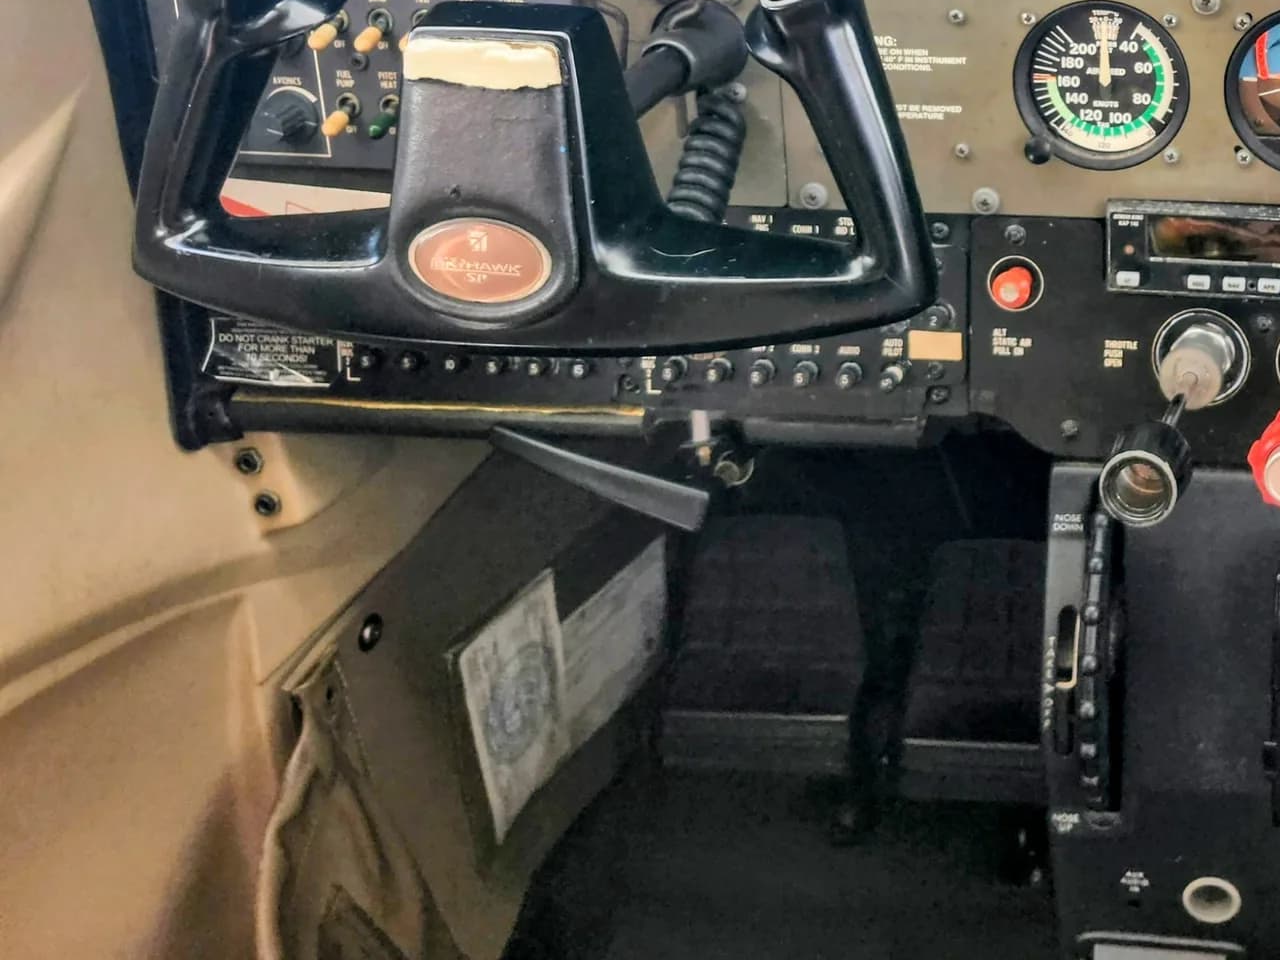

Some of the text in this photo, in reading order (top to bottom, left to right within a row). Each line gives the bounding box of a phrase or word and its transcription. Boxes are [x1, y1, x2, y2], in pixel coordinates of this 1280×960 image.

[1069, 43, 1096, 55] 200
[1119, 41, 1138, 53] 40
[1061, 57, 1084, 69] 180
[1134, 62, 1152, 74] 60
[1058, 75, 1080, 87] 160
[1066, 93, 1088, 104] 140
[1132, 93, 1150, 105] 80
[1080, 109, 1102, 121] 120
[1109, 112, 1131, 124] 100
[465, 272, 488, 284] SP
[219, 333, 334, 345] DO NOT CRANK STARTER
[238, 343, 315, 354] FOR MORE THAN
[1054, 513, 1081, 521] NOSE
